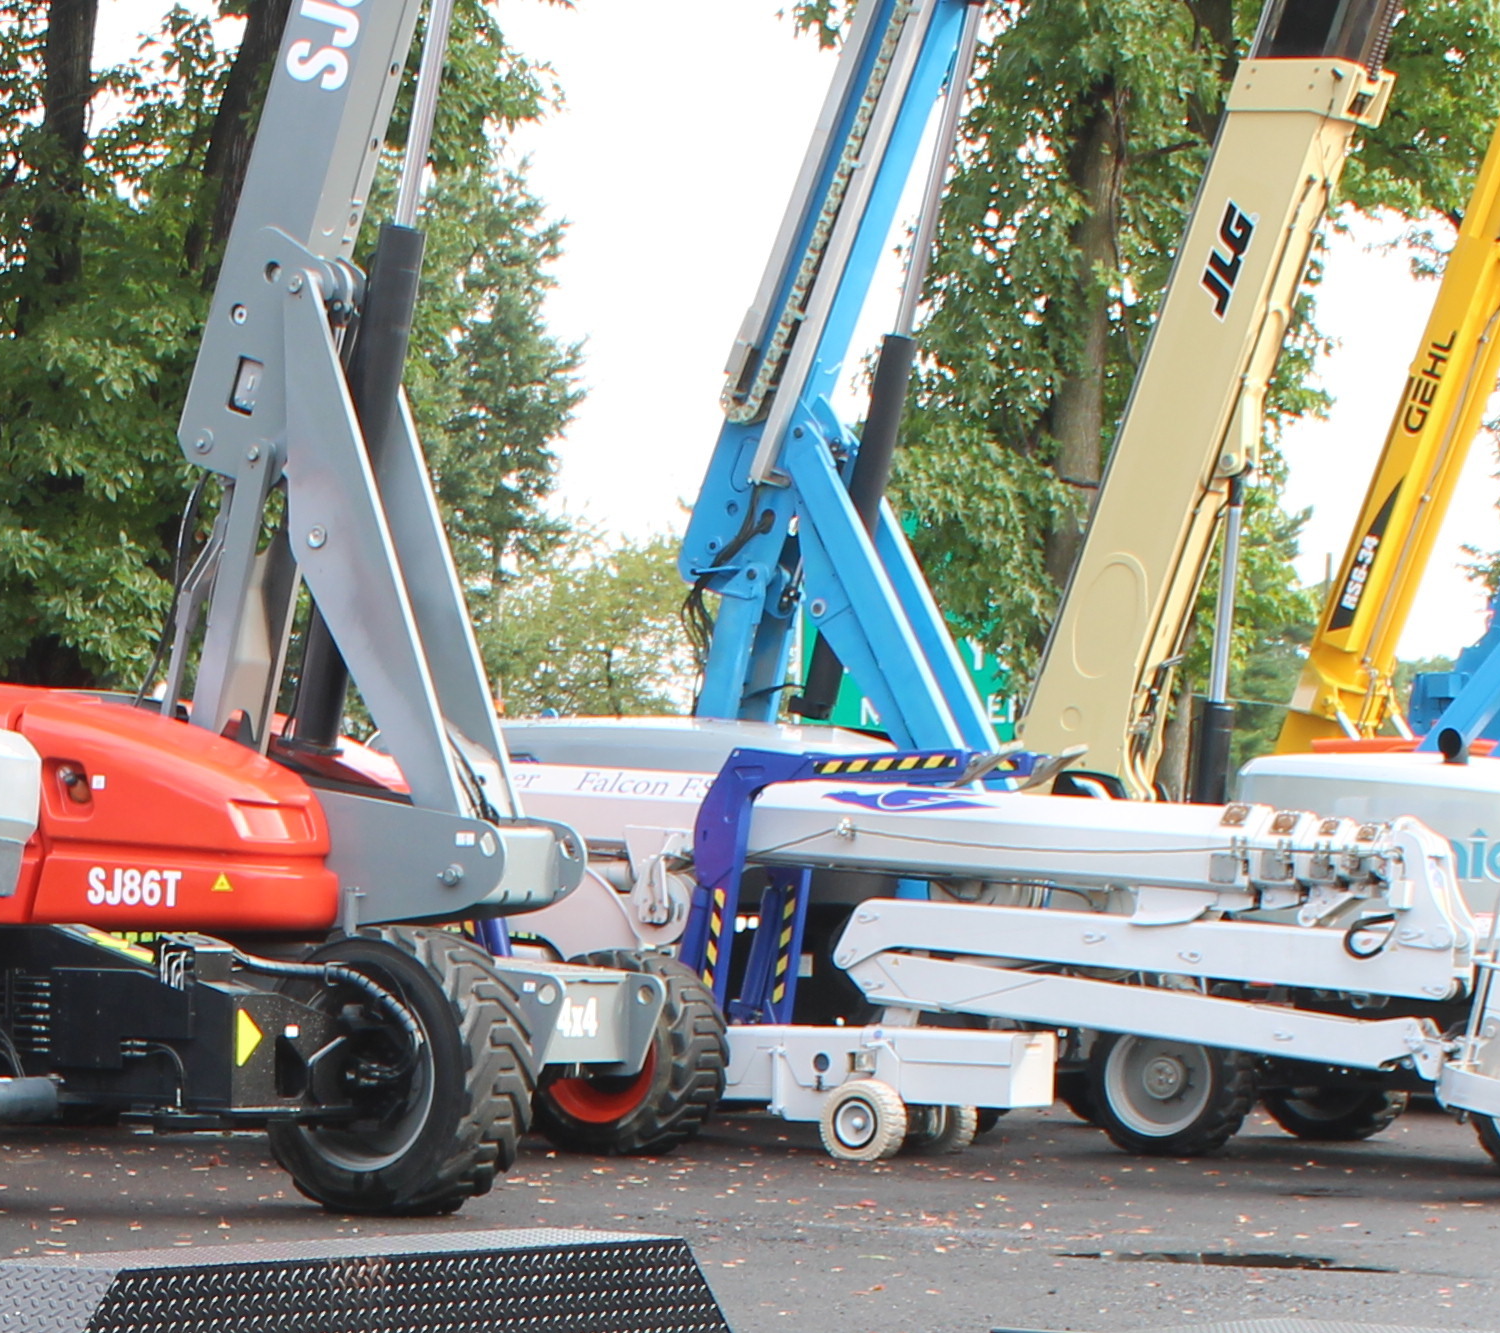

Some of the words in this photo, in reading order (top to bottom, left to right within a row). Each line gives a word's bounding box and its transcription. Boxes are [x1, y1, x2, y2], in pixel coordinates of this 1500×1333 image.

[286, 0, 360, 91] SJ
[1200, 199, 1256, 321] JLG
[1403, 331, 1456, 435] GEHL
[575, 771, 669, 796] Falcon
[87, 867, 182, 907] SJ86T
[557, 997, 598, 1037] 4x4
